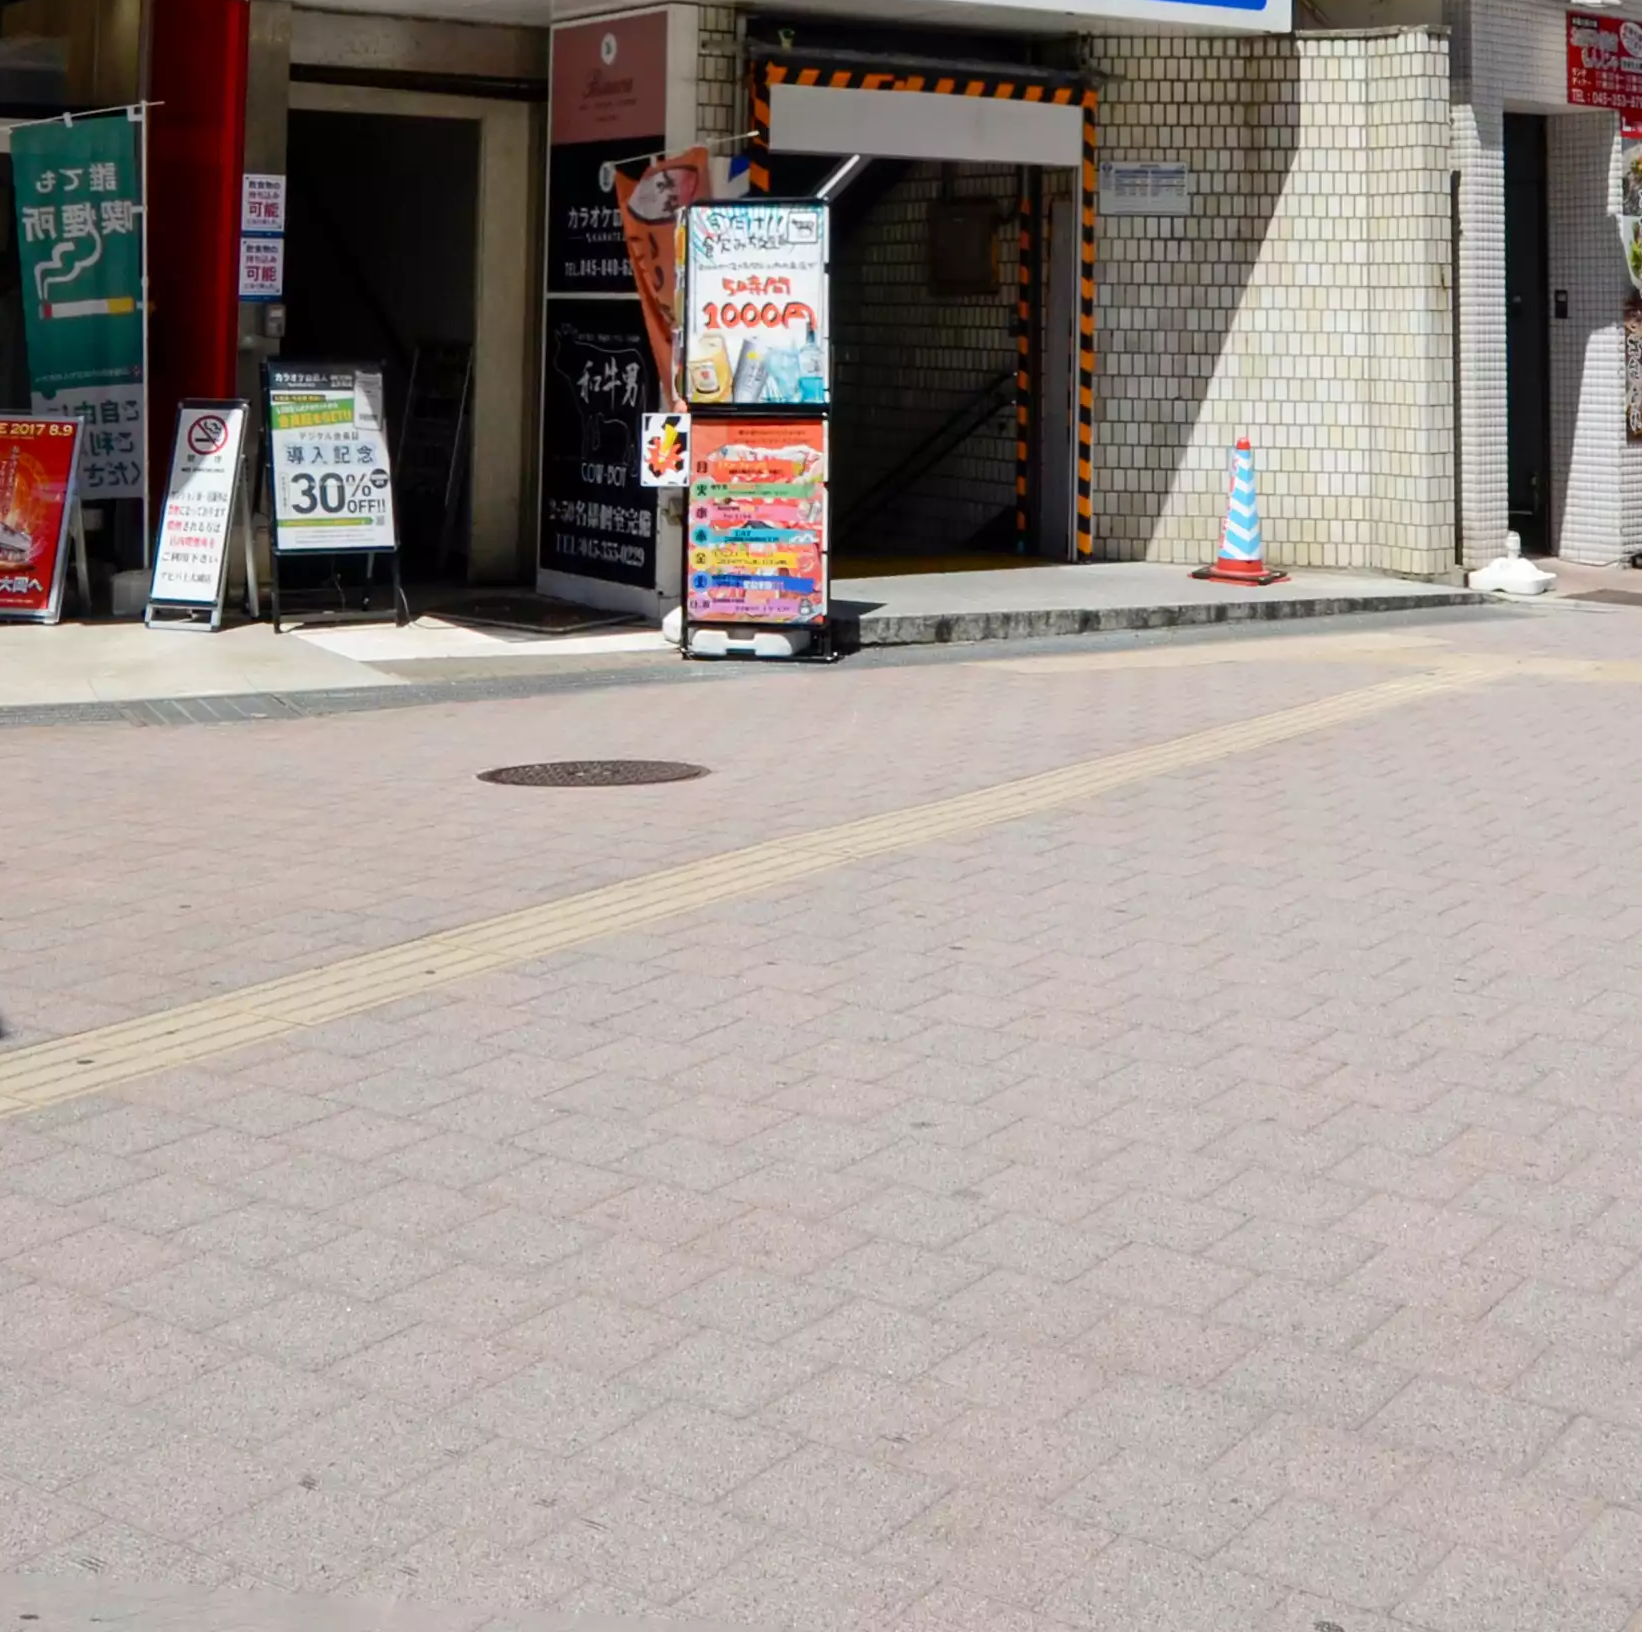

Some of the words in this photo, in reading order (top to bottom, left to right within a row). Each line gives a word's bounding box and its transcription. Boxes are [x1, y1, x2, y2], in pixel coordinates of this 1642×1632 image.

[248, 201, 280, 218] 可能
[245, 265, 277, 282] 可能
[576, 356, 641, 412] 和牛男
[9, 422, 46, 436] 2017
[48, 423, 74, 437] 8.9
[286, 444, 374, 466] 導入記念
[696, 484, 708, 497] 火
[347, 498, 387, 514] OFF!!
